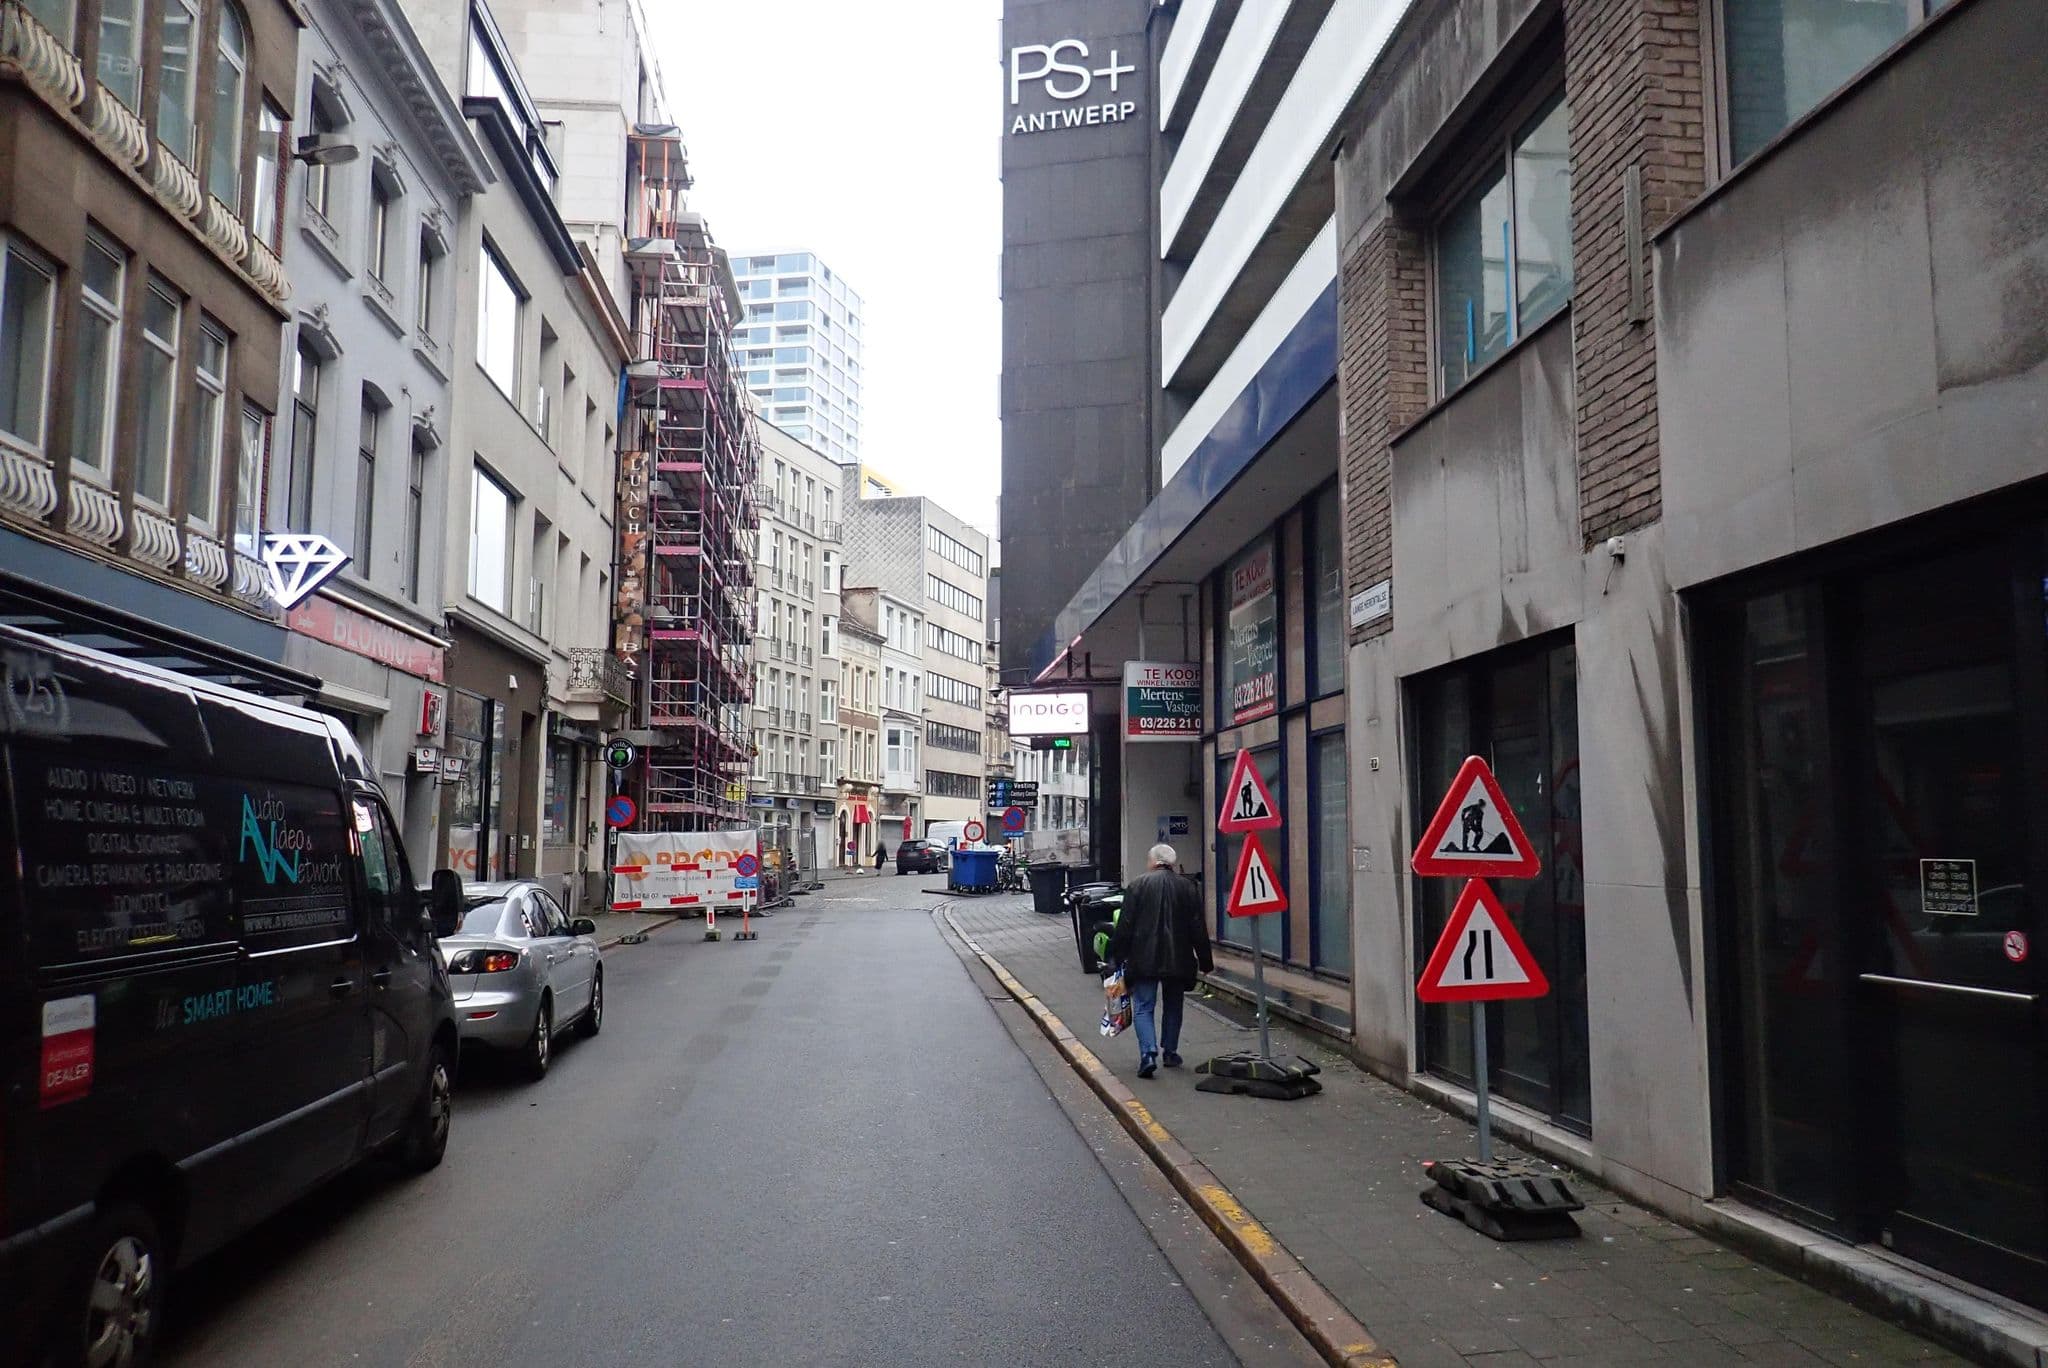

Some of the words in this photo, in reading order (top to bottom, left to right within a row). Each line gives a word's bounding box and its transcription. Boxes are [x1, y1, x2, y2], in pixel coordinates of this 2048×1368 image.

[1011, 39, 1135, 105] PS+
[1012, 101, 1136, 134] ANTWERP
[628, 458, 641, 535] LUNCH
[1144, 669, 1160, 679] TE
[1140, 688, 1184, 701] Mertens
[1140, 717, 1176, 729] 03/226
[1179, 717, 1191, 728] 21
[48, 767, 88, 791] AUDIO
[183, 989, 233, 1024] SMART
[237, 980, 272, 1009] HOME
[47, 1062, 90, 1088] DEALER
